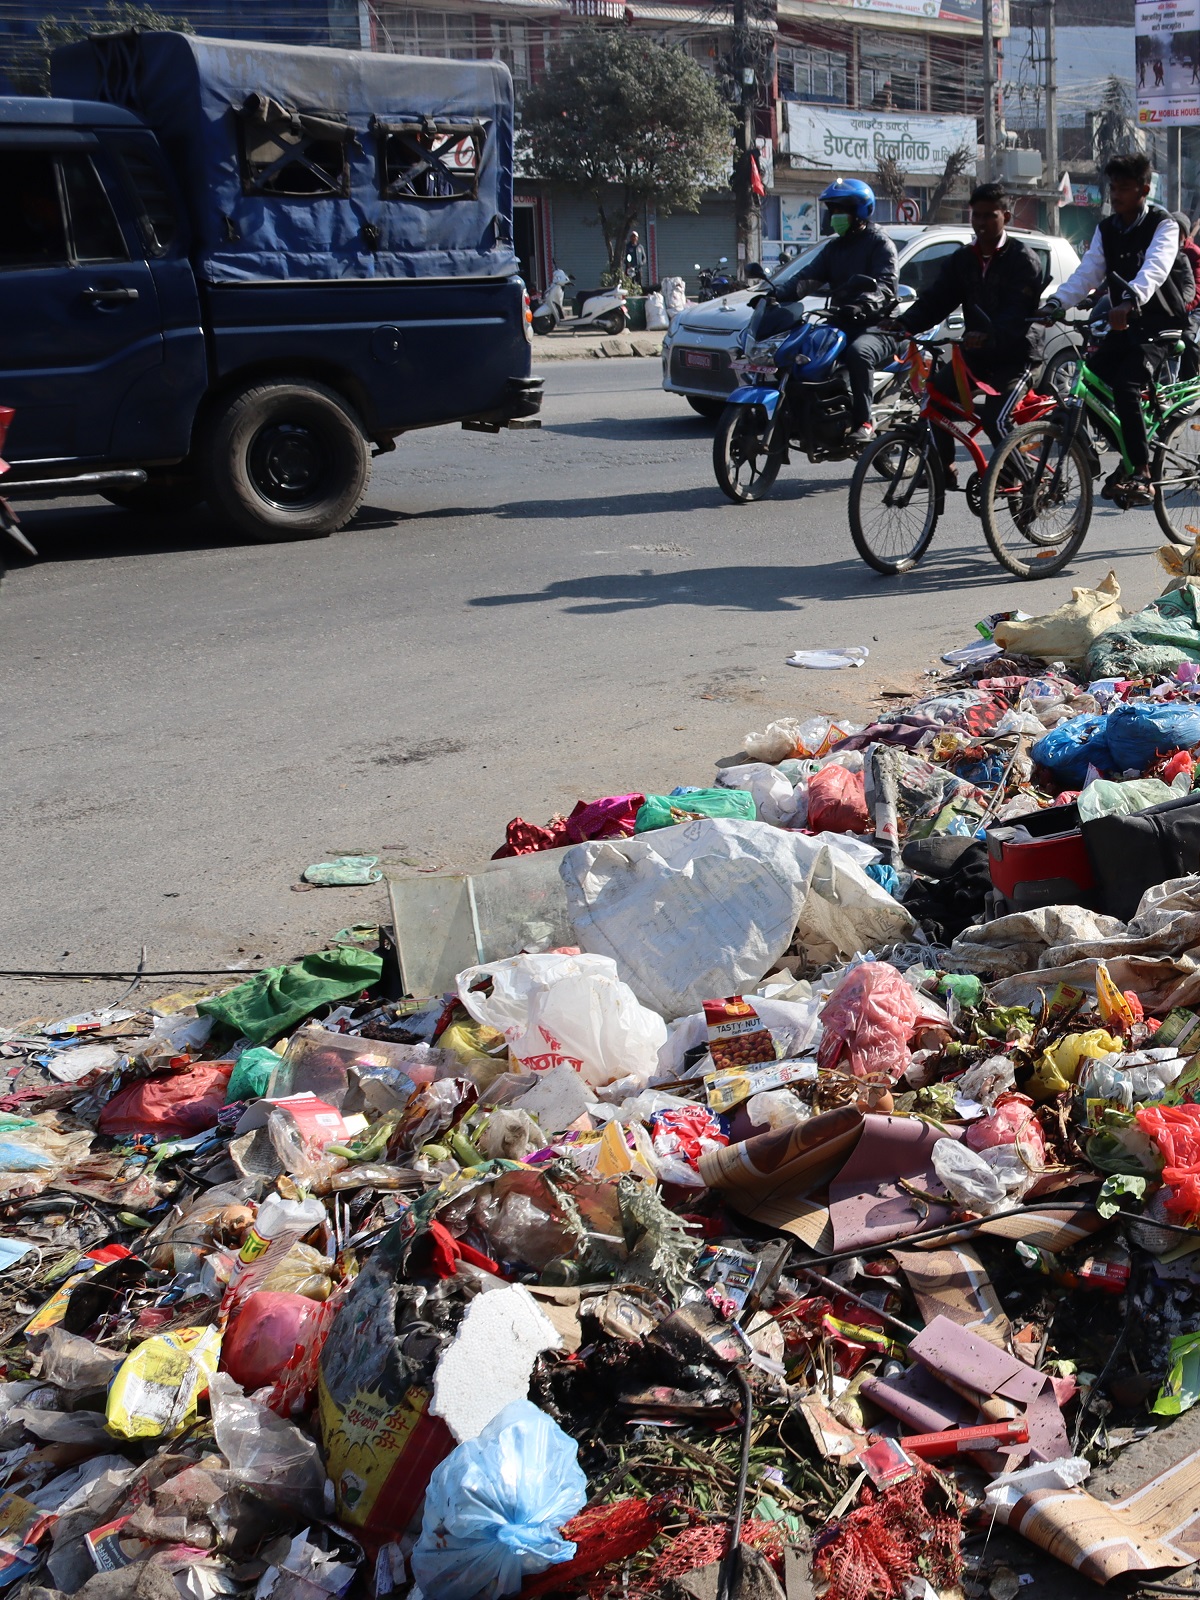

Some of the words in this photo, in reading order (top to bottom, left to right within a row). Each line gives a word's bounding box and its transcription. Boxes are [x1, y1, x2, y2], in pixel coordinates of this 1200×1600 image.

[1158, 109, 1179, 117] MOBILE
[1180, 108, 1200, 117] HOUSE
[823, 129, 868, 159] डेण्टल
[716, 1022, 742, 1033] TASTY
[745, 1018, 761, 1027] NUT
